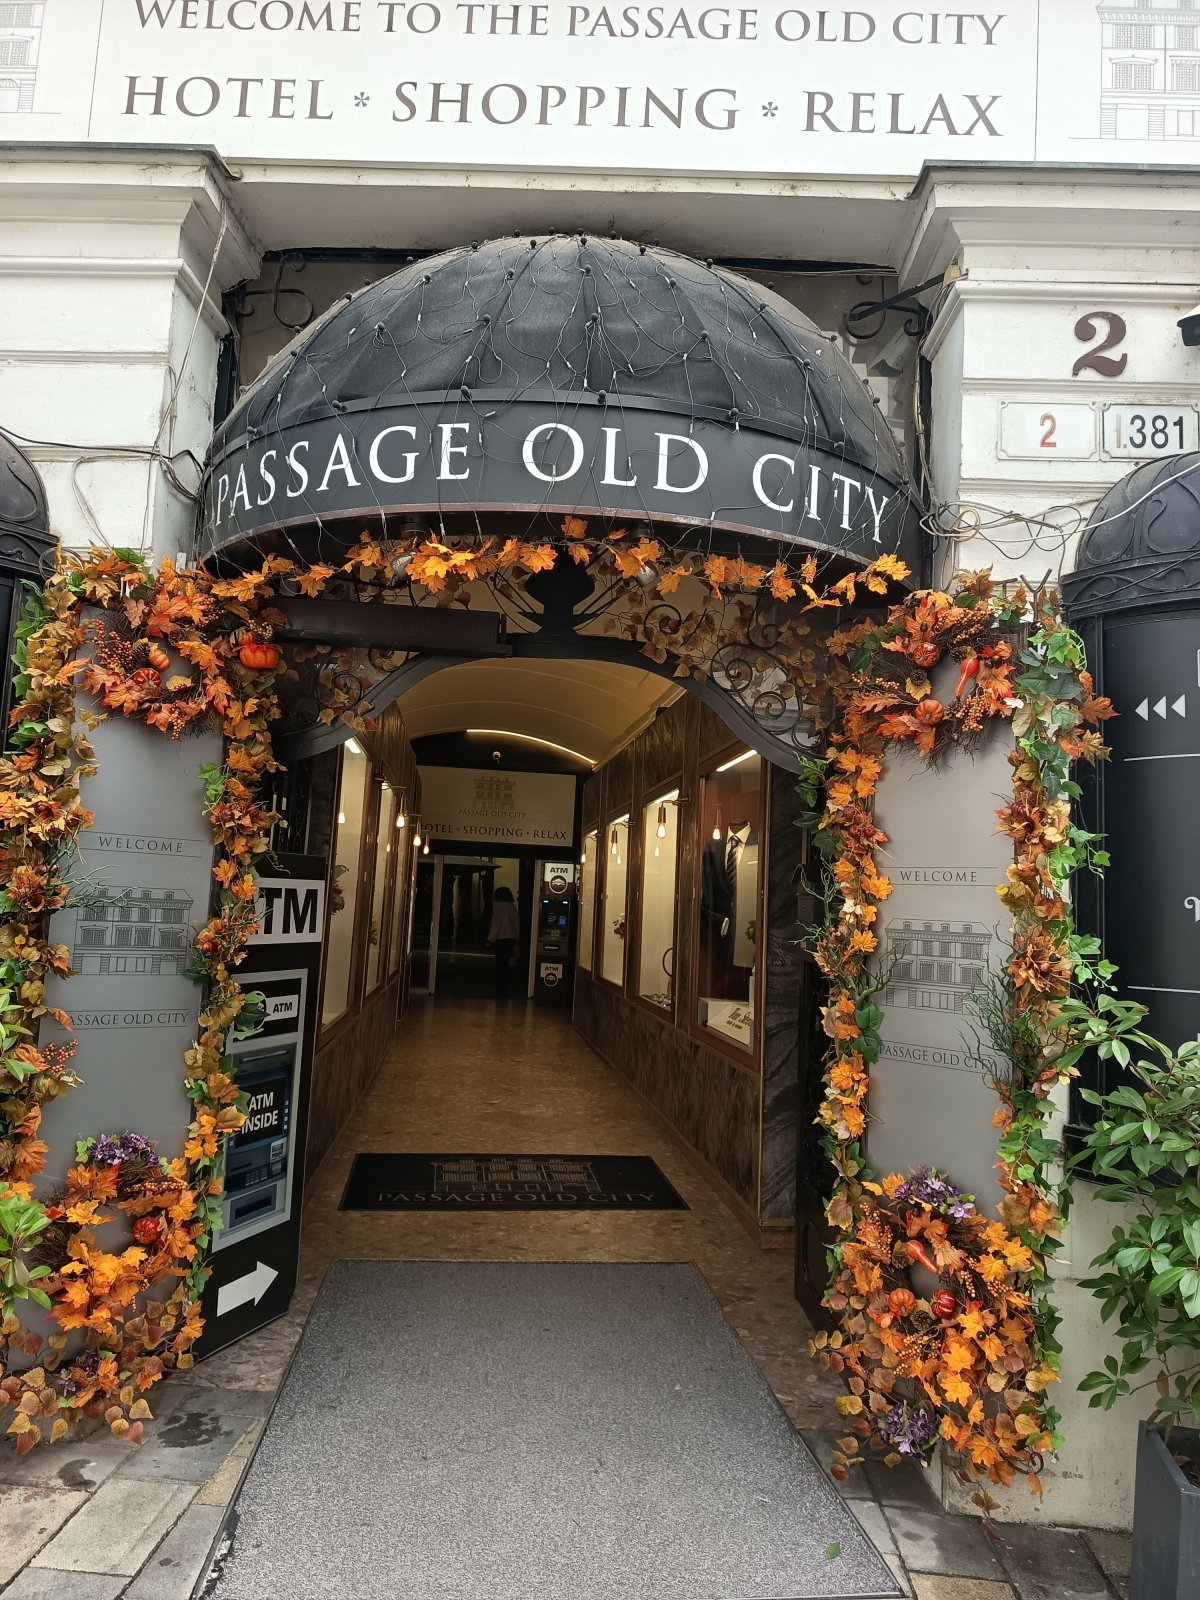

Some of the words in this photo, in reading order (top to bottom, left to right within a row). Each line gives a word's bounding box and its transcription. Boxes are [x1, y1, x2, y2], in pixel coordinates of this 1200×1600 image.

[134, 0, 361, 32] WELCOME
[377, 3, 442, 35] TO
[456, 4, 549, 37] THE
[566, 7, 758, 41] PASSAGE
[774, 9, 877, 44] OLD
[892, 12, 1006, 46] CITY
[121, 75, 334, 120] HOTEL
[392, 81, 740, 131] SHOPPING
[801, 90, 1003, 137] RELAX
[1072, 311, 1127, 377] 2
[1039, 413, 1057, 448] 2
[215, 422, 470, 528] PASSAGE
[522, 422, 710, 494] OLD
[752, 453, 890, 544] CITY
[458, 808, 488, 817] PASSAGE
[490, 810, 507, 818] OLD
[508, 811, 527, 819] CITY
[463, 825, 523, 838] SHOPPING
[533, 829, 567, 840] RELAX
[99, 836, 183, 853] WELCOME
[549, 866, 569, 874] ATM
[900, 870, 977, 883] WELCOME
[252, 887, 318, 935] TM
[273, 1002, 293, 1013] ATM
[123, 1013, 153, 1025] OLD
[157, 1012, 189, 1024] CITY
[880, 1042, 929, 1061] PASSAGE
[932, 1052, 960, 1066] OLD
[248, 1091, 274, 1112] ATM
[378, 1193, 504, 1202] PASSAGE
[514, 1193, 578, 1202] OLD
[588, 1193, 655, 1202] CITY
